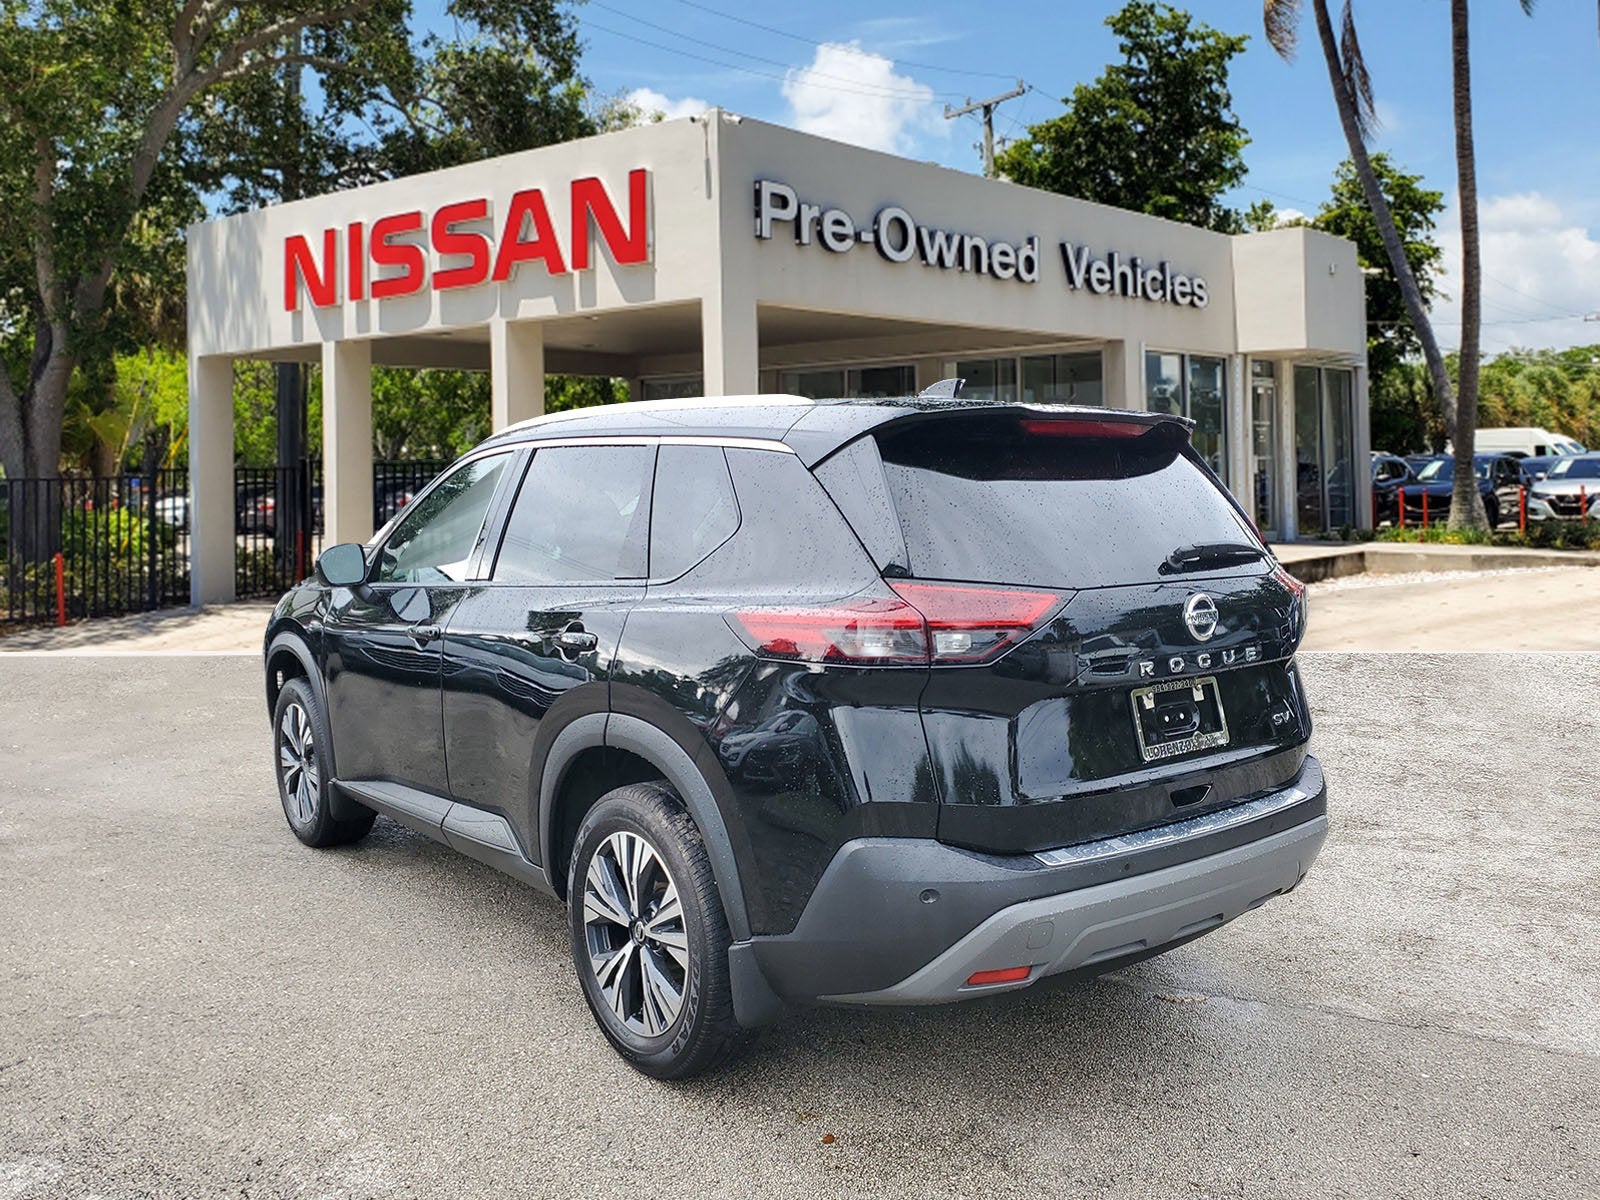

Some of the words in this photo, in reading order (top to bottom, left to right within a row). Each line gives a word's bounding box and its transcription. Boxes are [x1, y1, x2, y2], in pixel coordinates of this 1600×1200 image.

[284, 168, 649, 312] NISSAN
[754, 179, 1041, 283] Pre-Owned
[1060, 241, 1209, 309] Vehicles
[1189, 610, 1218, 625] NISSAN
[1139, 646, 1258, 677] ROGUE
[1273, 710, 1290, 726] SV
